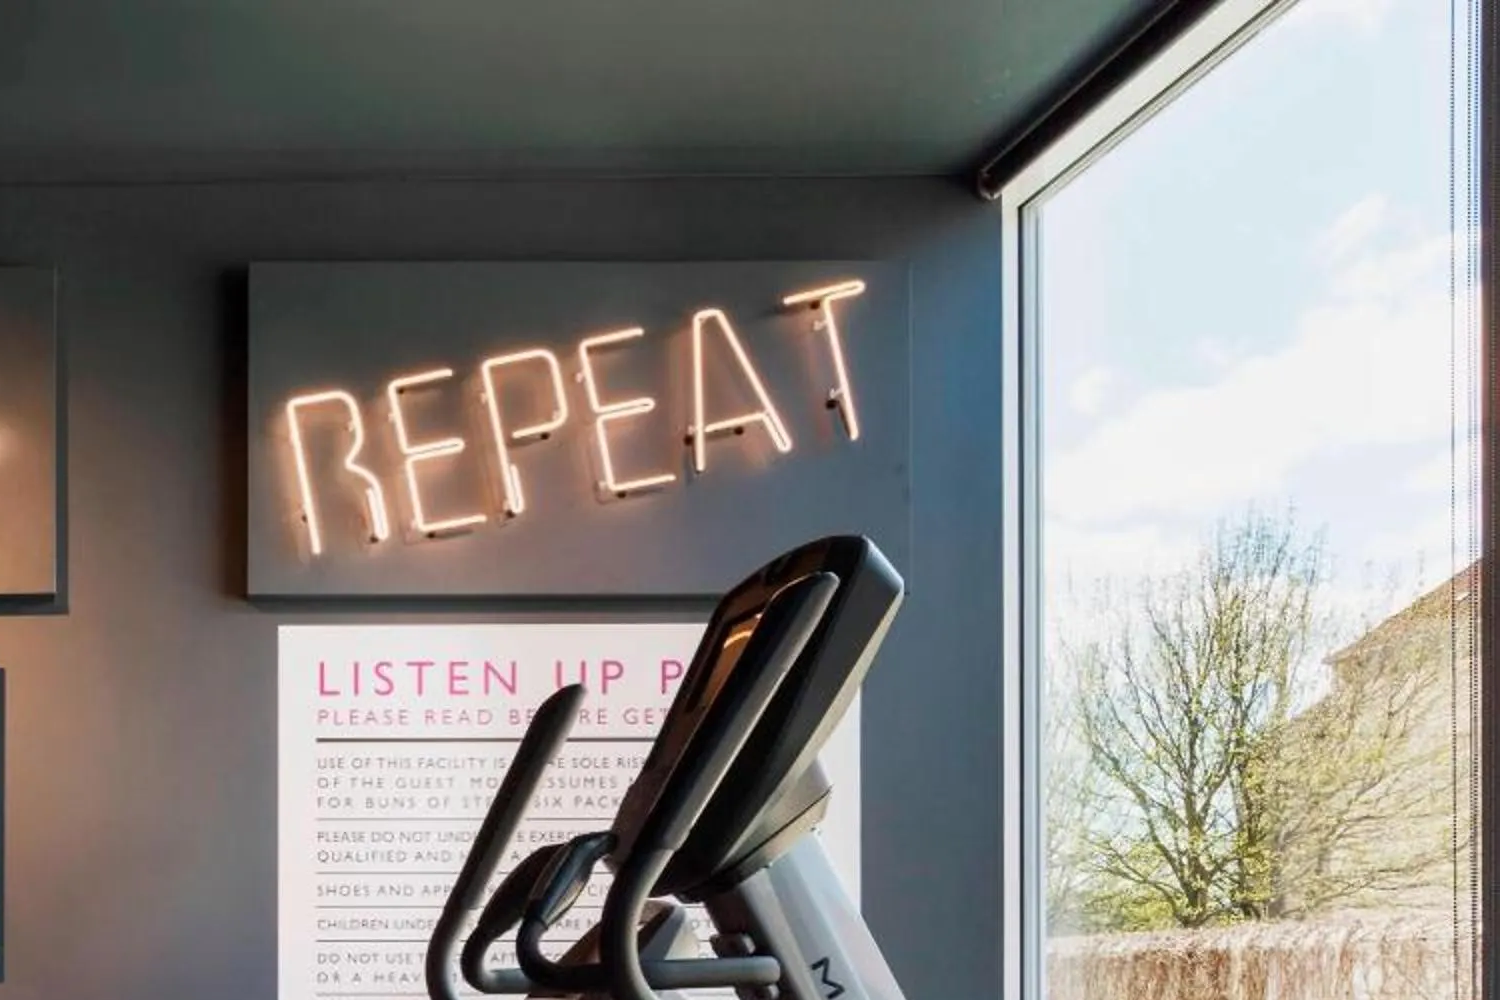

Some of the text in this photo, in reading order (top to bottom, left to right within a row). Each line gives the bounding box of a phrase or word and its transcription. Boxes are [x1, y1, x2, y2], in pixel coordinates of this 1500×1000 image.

[285, 279, 867, 557] REPEAT
[318, 660, 517, 697] LISTEN
[554, 660, 624, 696] UP
[317, 709, 410, 726] PLEASE
[424, 708, 495, 726] READ
[508, 707, 609, 726] BERE
[317, 756, 345, 770] USE
[350, 756, 371, 770] OF
[376, 756, 412, 770] THIS
[416, 756, 488, 770] FACILITY
[492, 756, 507, 770] IS
[571, 756, 610, 769] SOLE
[317, 776, 341, 790] OF
[350, 776, 386, 790] THE
[544, 775, 619, 789] SSUMES
[316, 796, 352, 810] FOR
[364, 796, 418, 810] BUNS
[426, 796, 450, 810] OF
[316, 831, 366, 844] PLEASE
[370, 831, 395, 844] DO
[400, 831, 432, 844] NOT
[316, 849, 408, 864] QUALIFIED
[413, 850, 452, 863] AND
[316, 884, 370, 898] SHOES
[376, 884, 414, 898] AND
[316, 918, 389, 931] CHILDREN
[393, 918, 435, 931] UNDE
[316, 952, 342, 965] DO
[347, 952, 379, 965] NOT
[385, 952, 415, 965] USE
[316, 971, 423, 984] OR A HEAV
